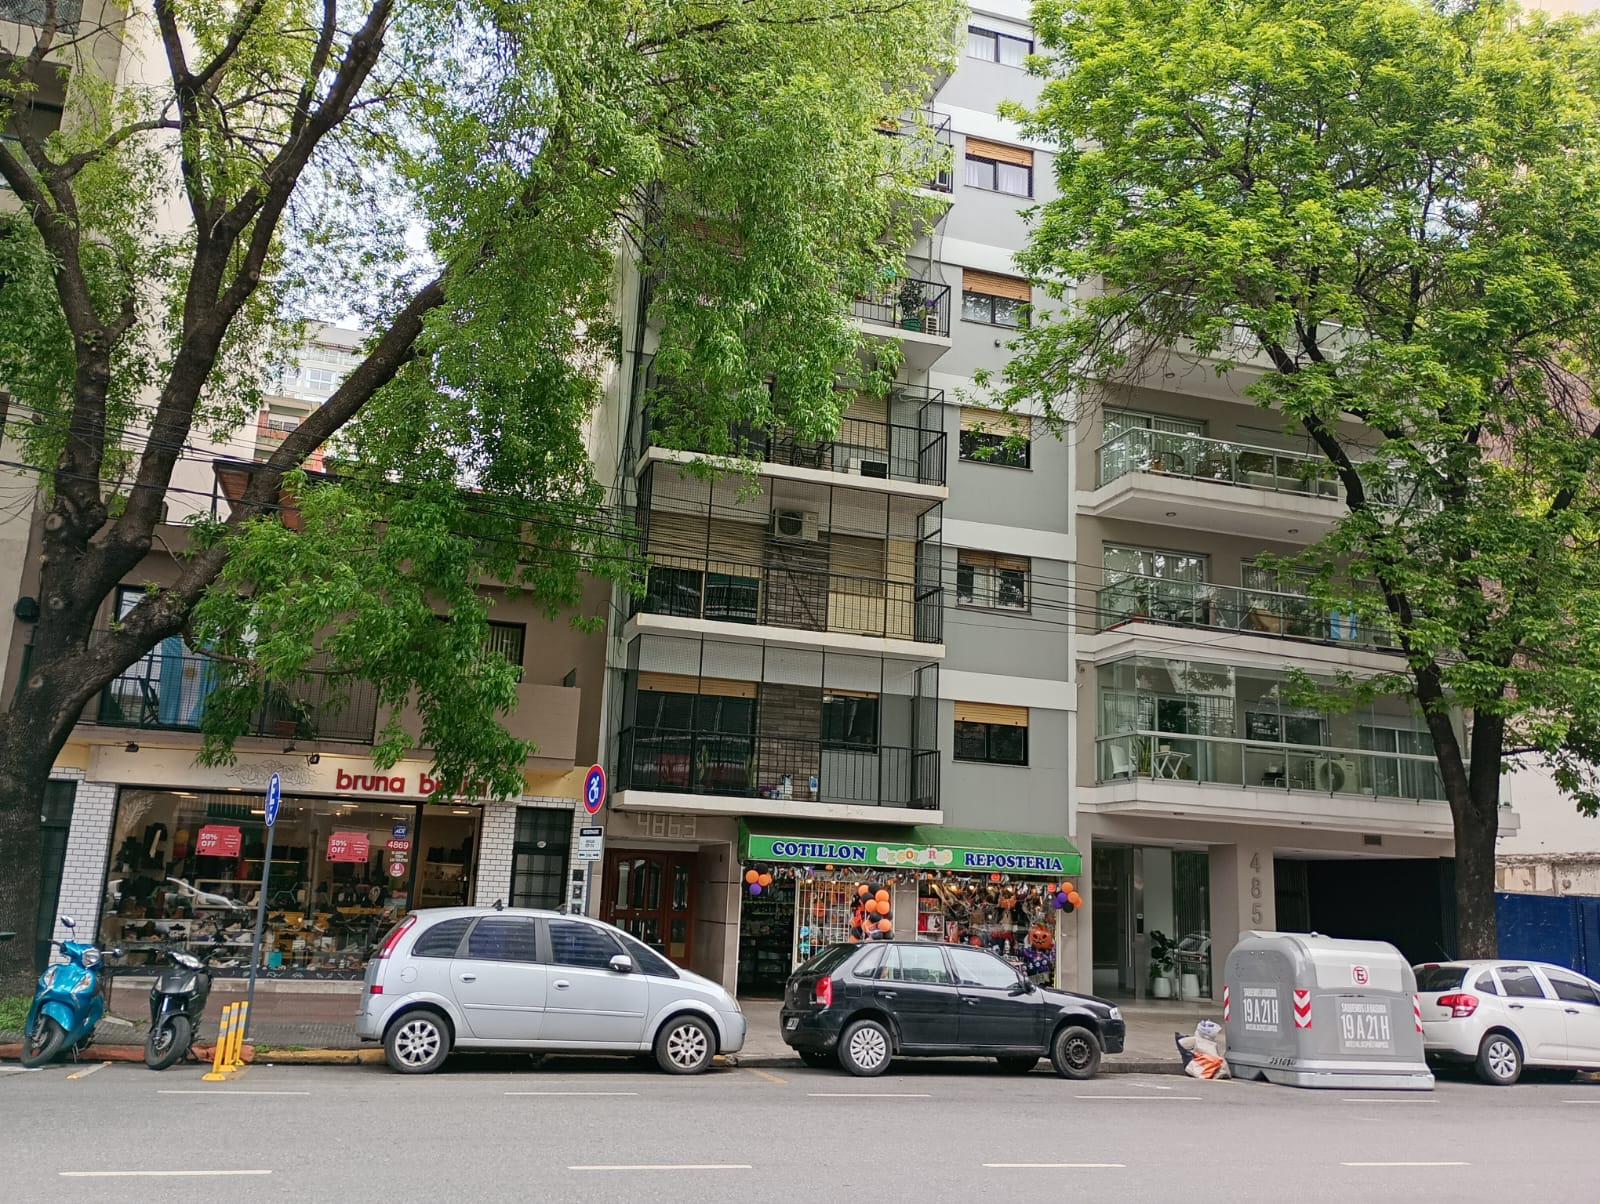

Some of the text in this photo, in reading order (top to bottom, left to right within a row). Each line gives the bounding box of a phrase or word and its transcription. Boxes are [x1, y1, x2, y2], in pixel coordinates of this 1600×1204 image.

[336, 769, 406, 793] bruna
[331, 839, 347, 847] 50%
[331, 846, 346, 854] OFF
[387, 840, 409, 850] 4869
[772, 842, 866, 860] COTILLON
[964, 853, 1063, 871] REPOSTERIA
[1243, 998, 1279, 1025] 19 A 21 H
[1341, 1014, 1390, 1041] 19 A 21 H
